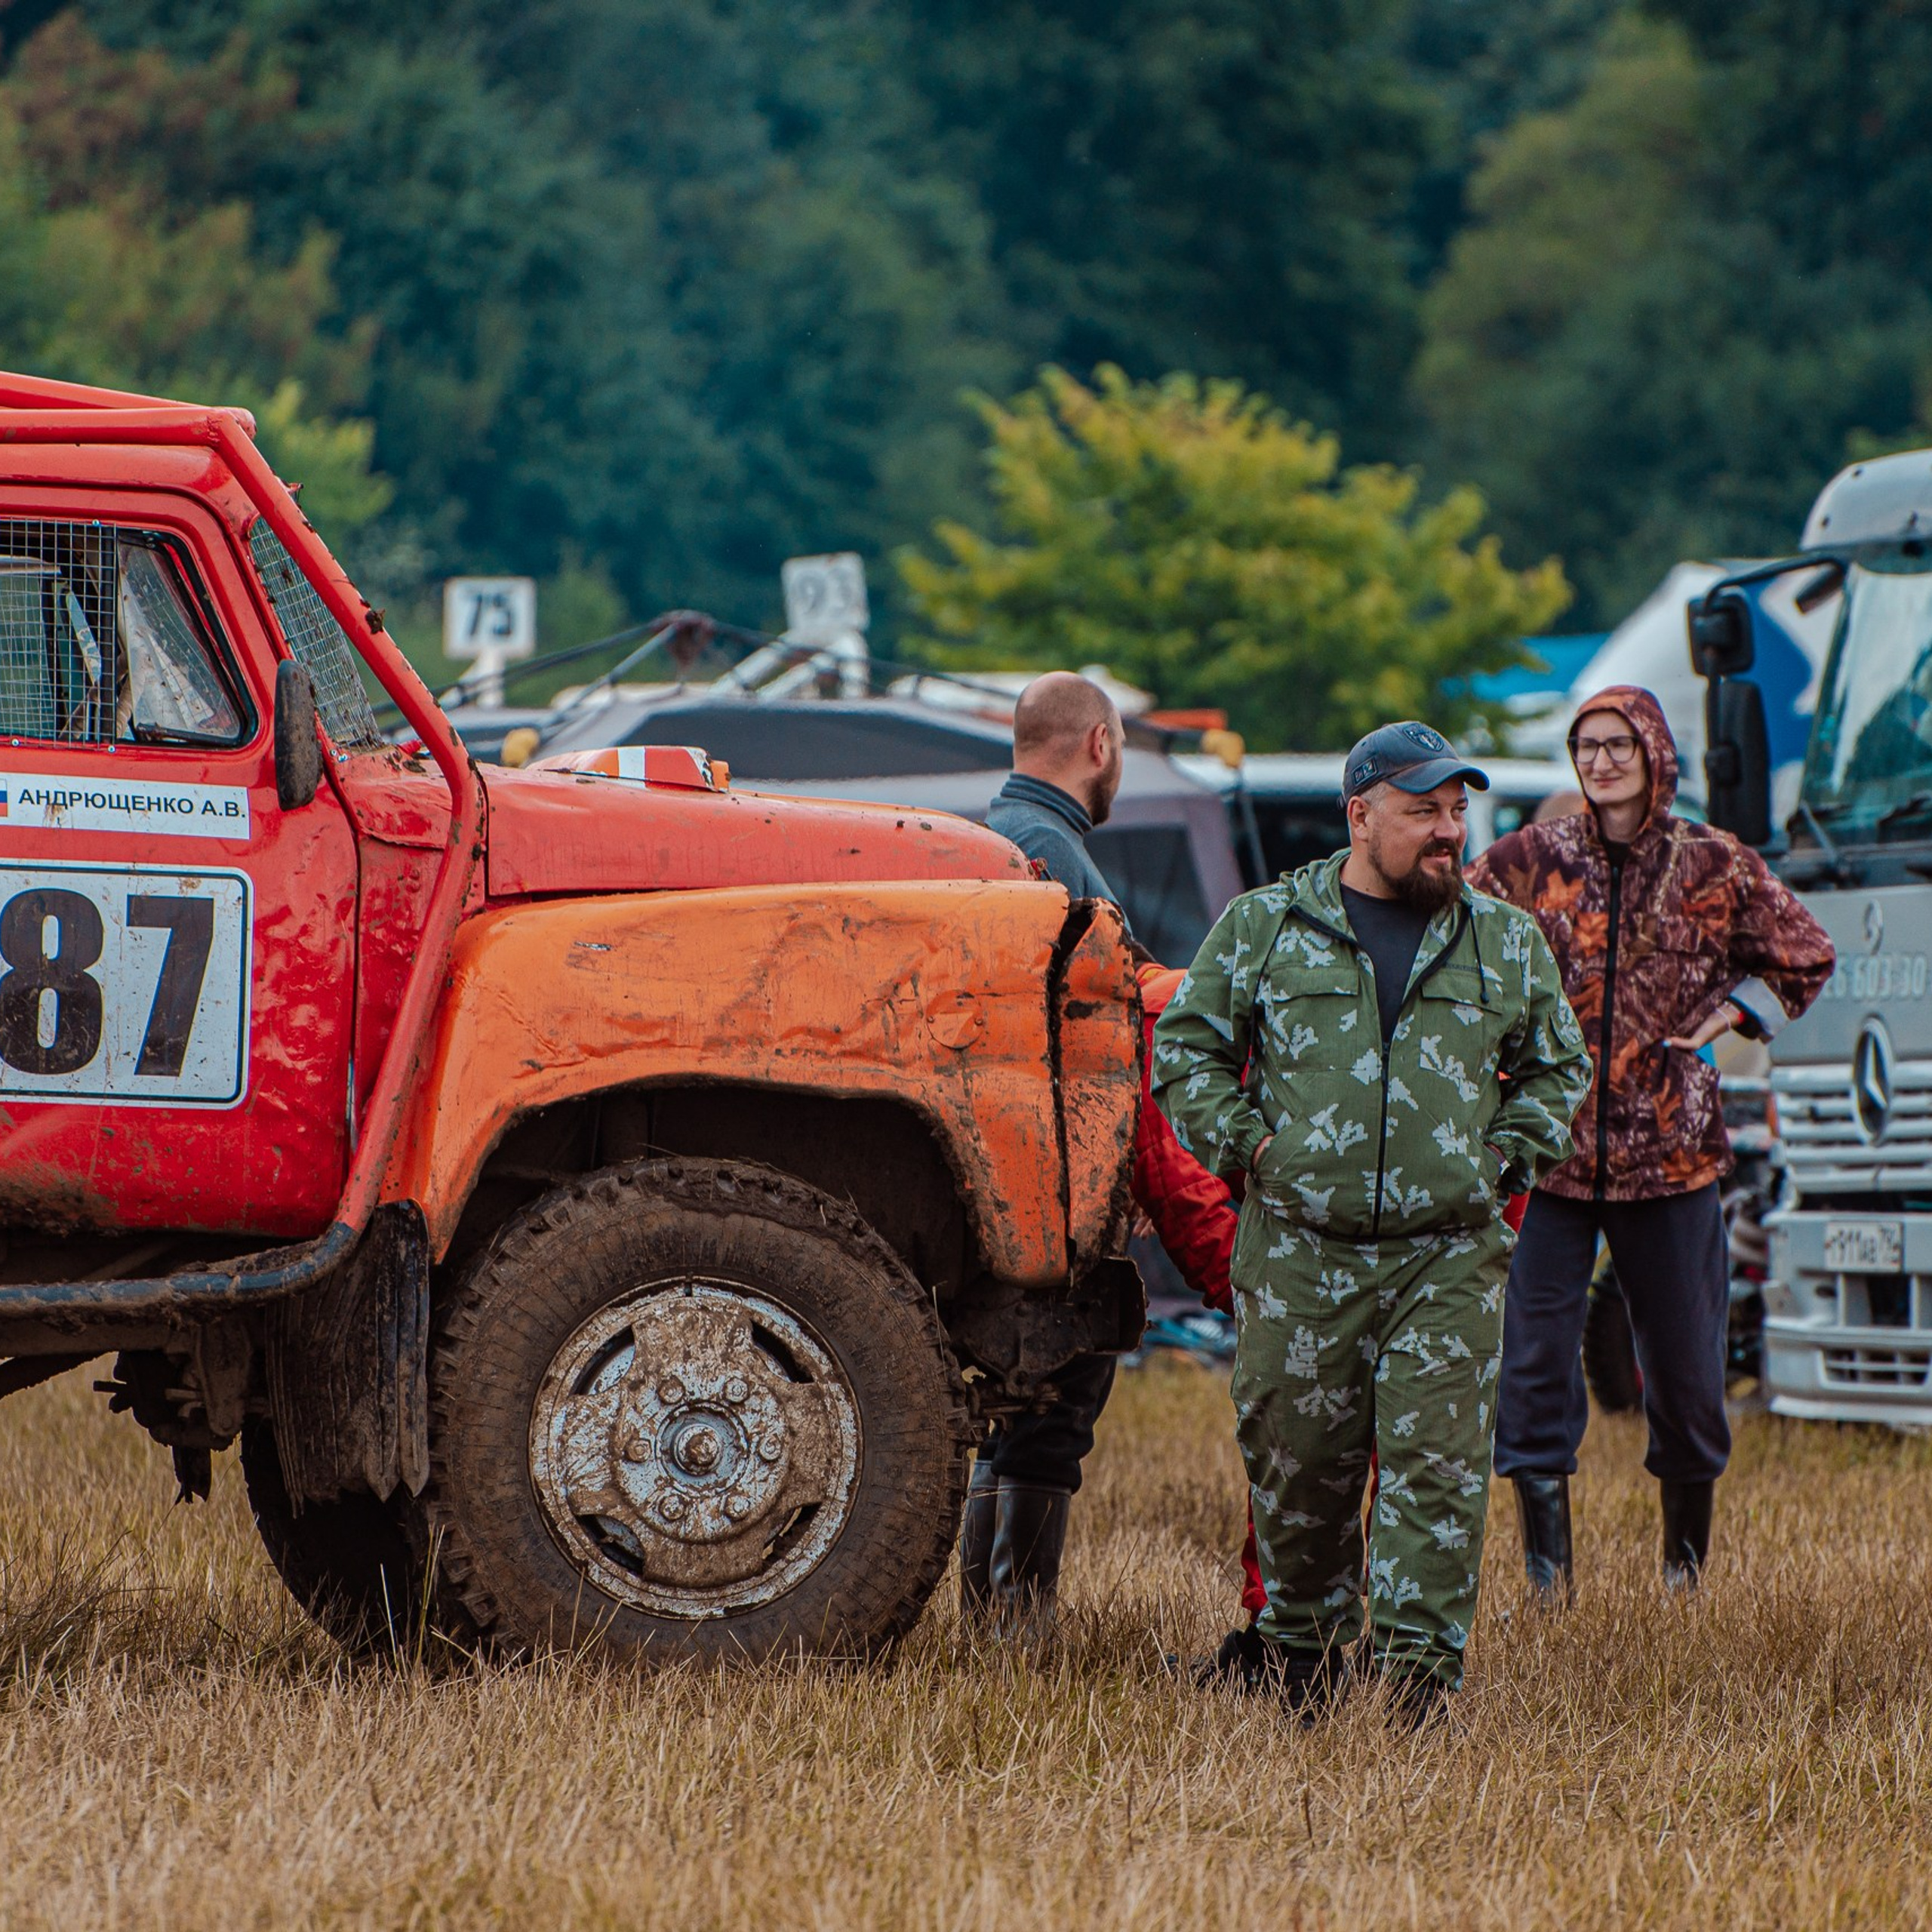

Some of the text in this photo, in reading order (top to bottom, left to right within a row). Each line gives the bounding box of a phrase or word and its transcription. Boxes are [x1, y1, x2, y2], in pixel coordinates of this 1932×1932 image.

[18, 789, 246, 818] АНДРЮЩЕНКО А.В.
[0, 888, 215, 1077] 87
